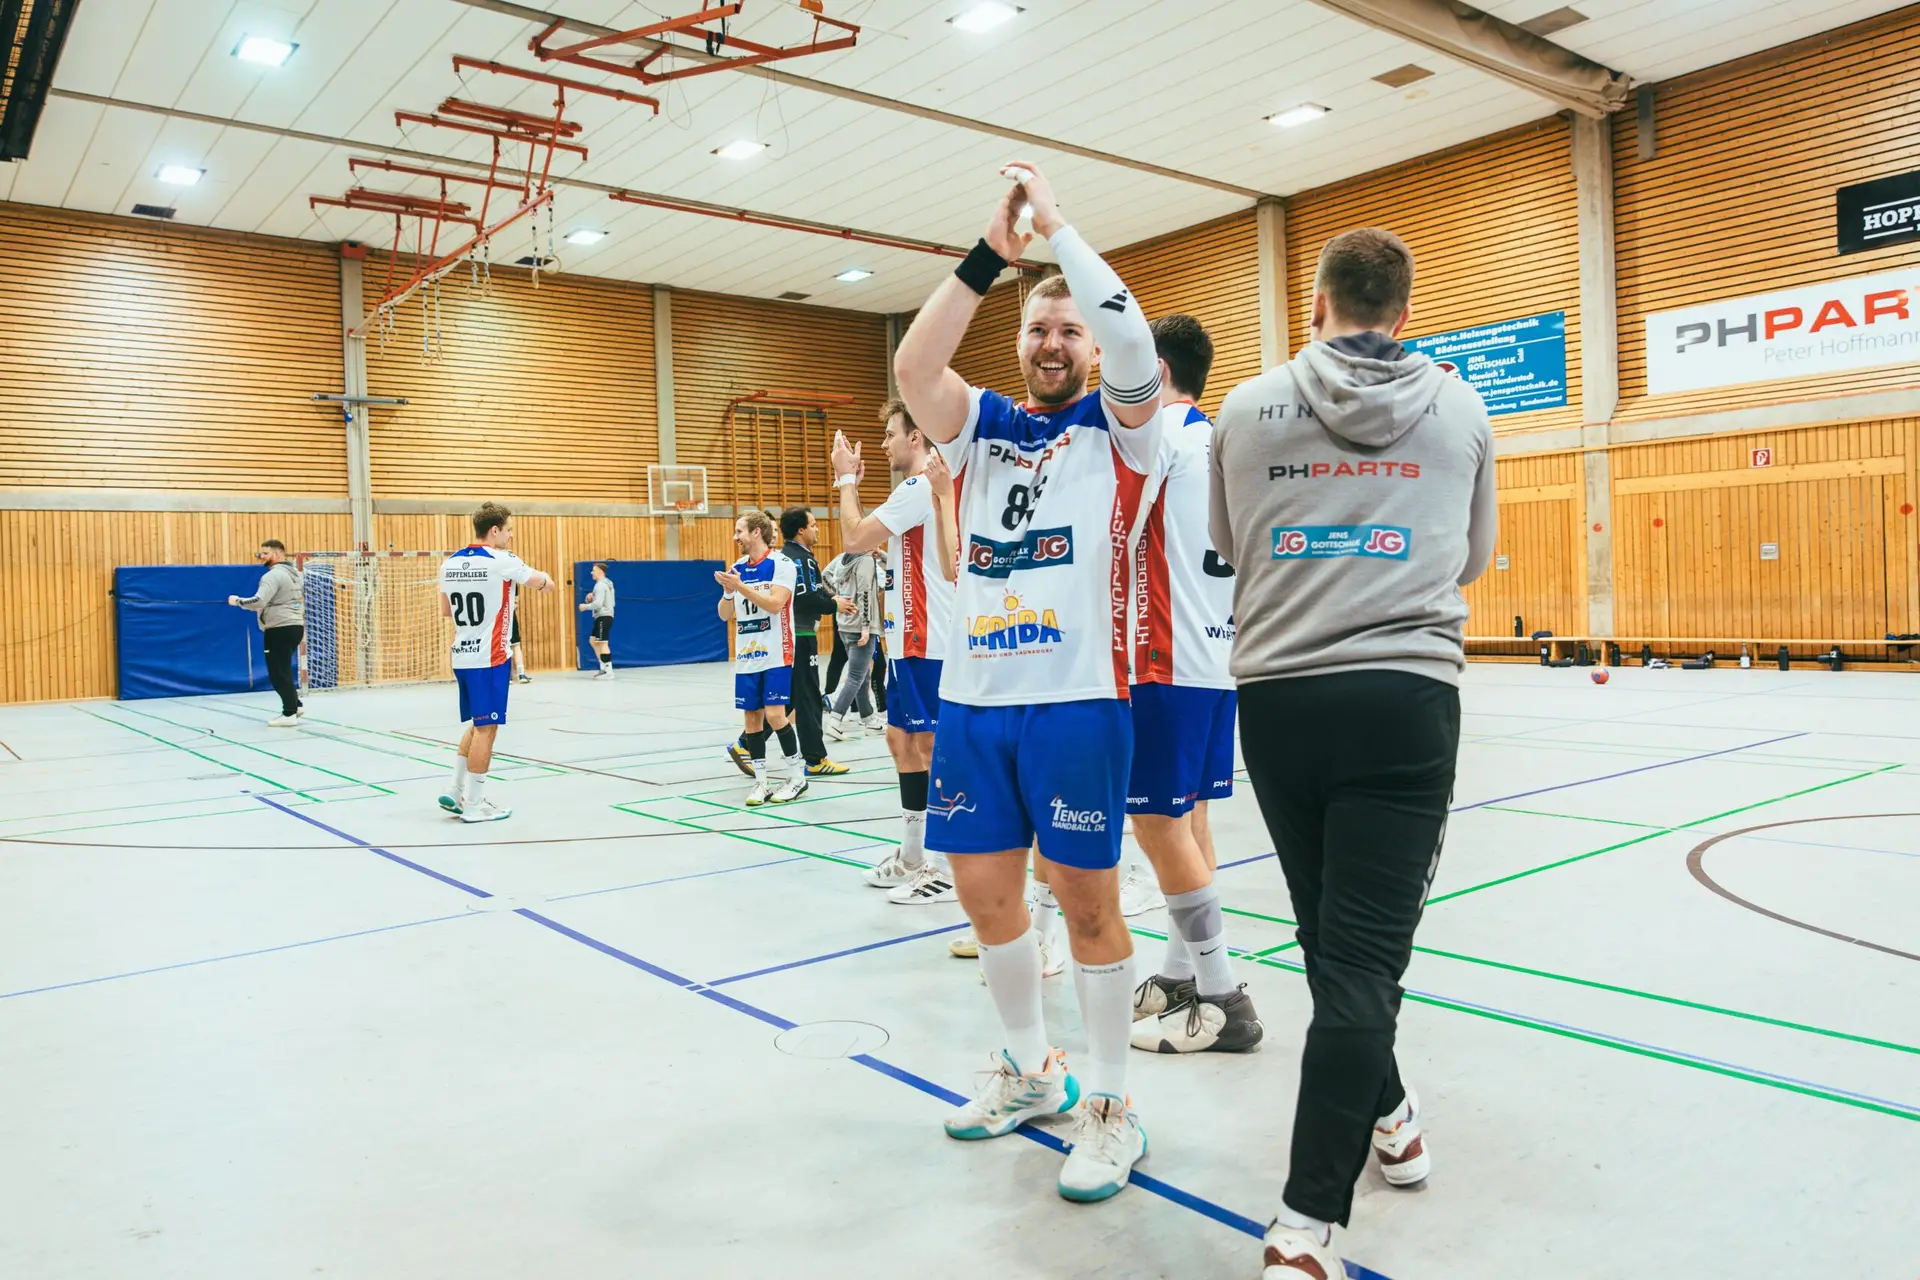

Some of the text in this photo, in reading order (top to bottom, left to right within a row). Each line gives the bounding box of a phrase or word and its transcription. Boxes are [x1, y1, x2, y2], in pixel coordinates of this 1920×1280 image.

[1676, 286, 1920, 354] PHPAR
[1435, 334, 1516, 355] Bäderausstellung
[1764, 345, 1813, 364] Peter
[1467, 356, 1516, 372] GOTTSCHALK
[1493, 372, 1535, 386] Norderstedt
[1259, 404, 1289, 421] HT
[1269, 461, 1420, 481] PHPARTS
[1032, 535, 1069, 561] JG
[1275, 531, 1307, 554] JG
[1364, 529, 1405, 554] JG
[904, 533, 913, 633] HT NORDERSTEDT
[450, 591, 485, 627] 20
[1114, 623, 1125, 652] HT
[1137, 624, 1149, 645] HT
[1126, 796, 1149, 805] empa
[1052, 820, 1106, 832] HANDBALL DE
